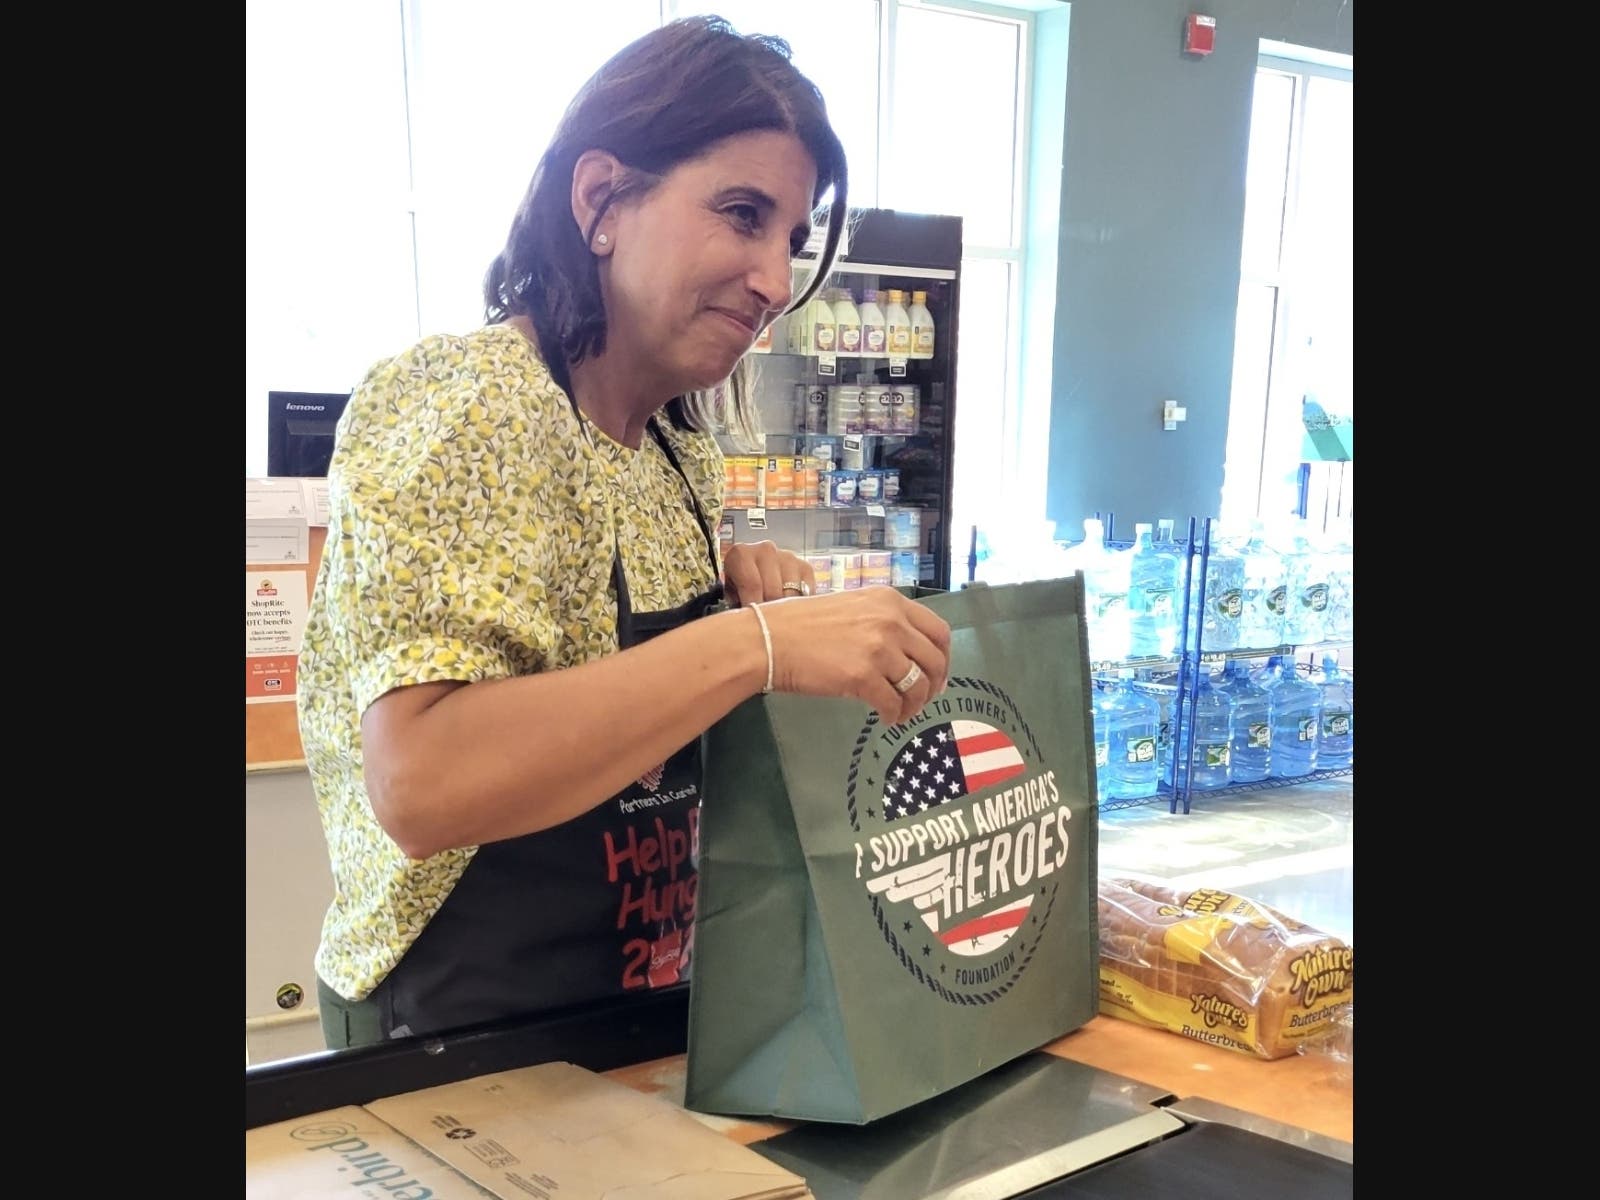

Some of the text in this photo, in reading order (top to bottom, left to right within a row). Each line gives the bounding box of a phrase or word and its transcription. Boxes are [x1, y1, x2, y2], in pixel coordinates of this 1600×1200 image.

[286, 402, 325, 411] lenovo
[251, 599, 285, 608] ShopRite
[263, 617, 292, 626] benefits
[933, 699, 951, 716] TO
[956, 697, 1006, 724] TOWERS
[869, 808, 970, 872] SUPPORT
[972, 770, 1060, 836] AMERICA'S
[603, 816, 687, 882] Help
[942, 805, 1071, 919] HEROES
[954, 951, 1016, 985] FOUNDATION
[1303, 971, 1345, 1008] Own
[307, 1136, 433, 1200] erbird
